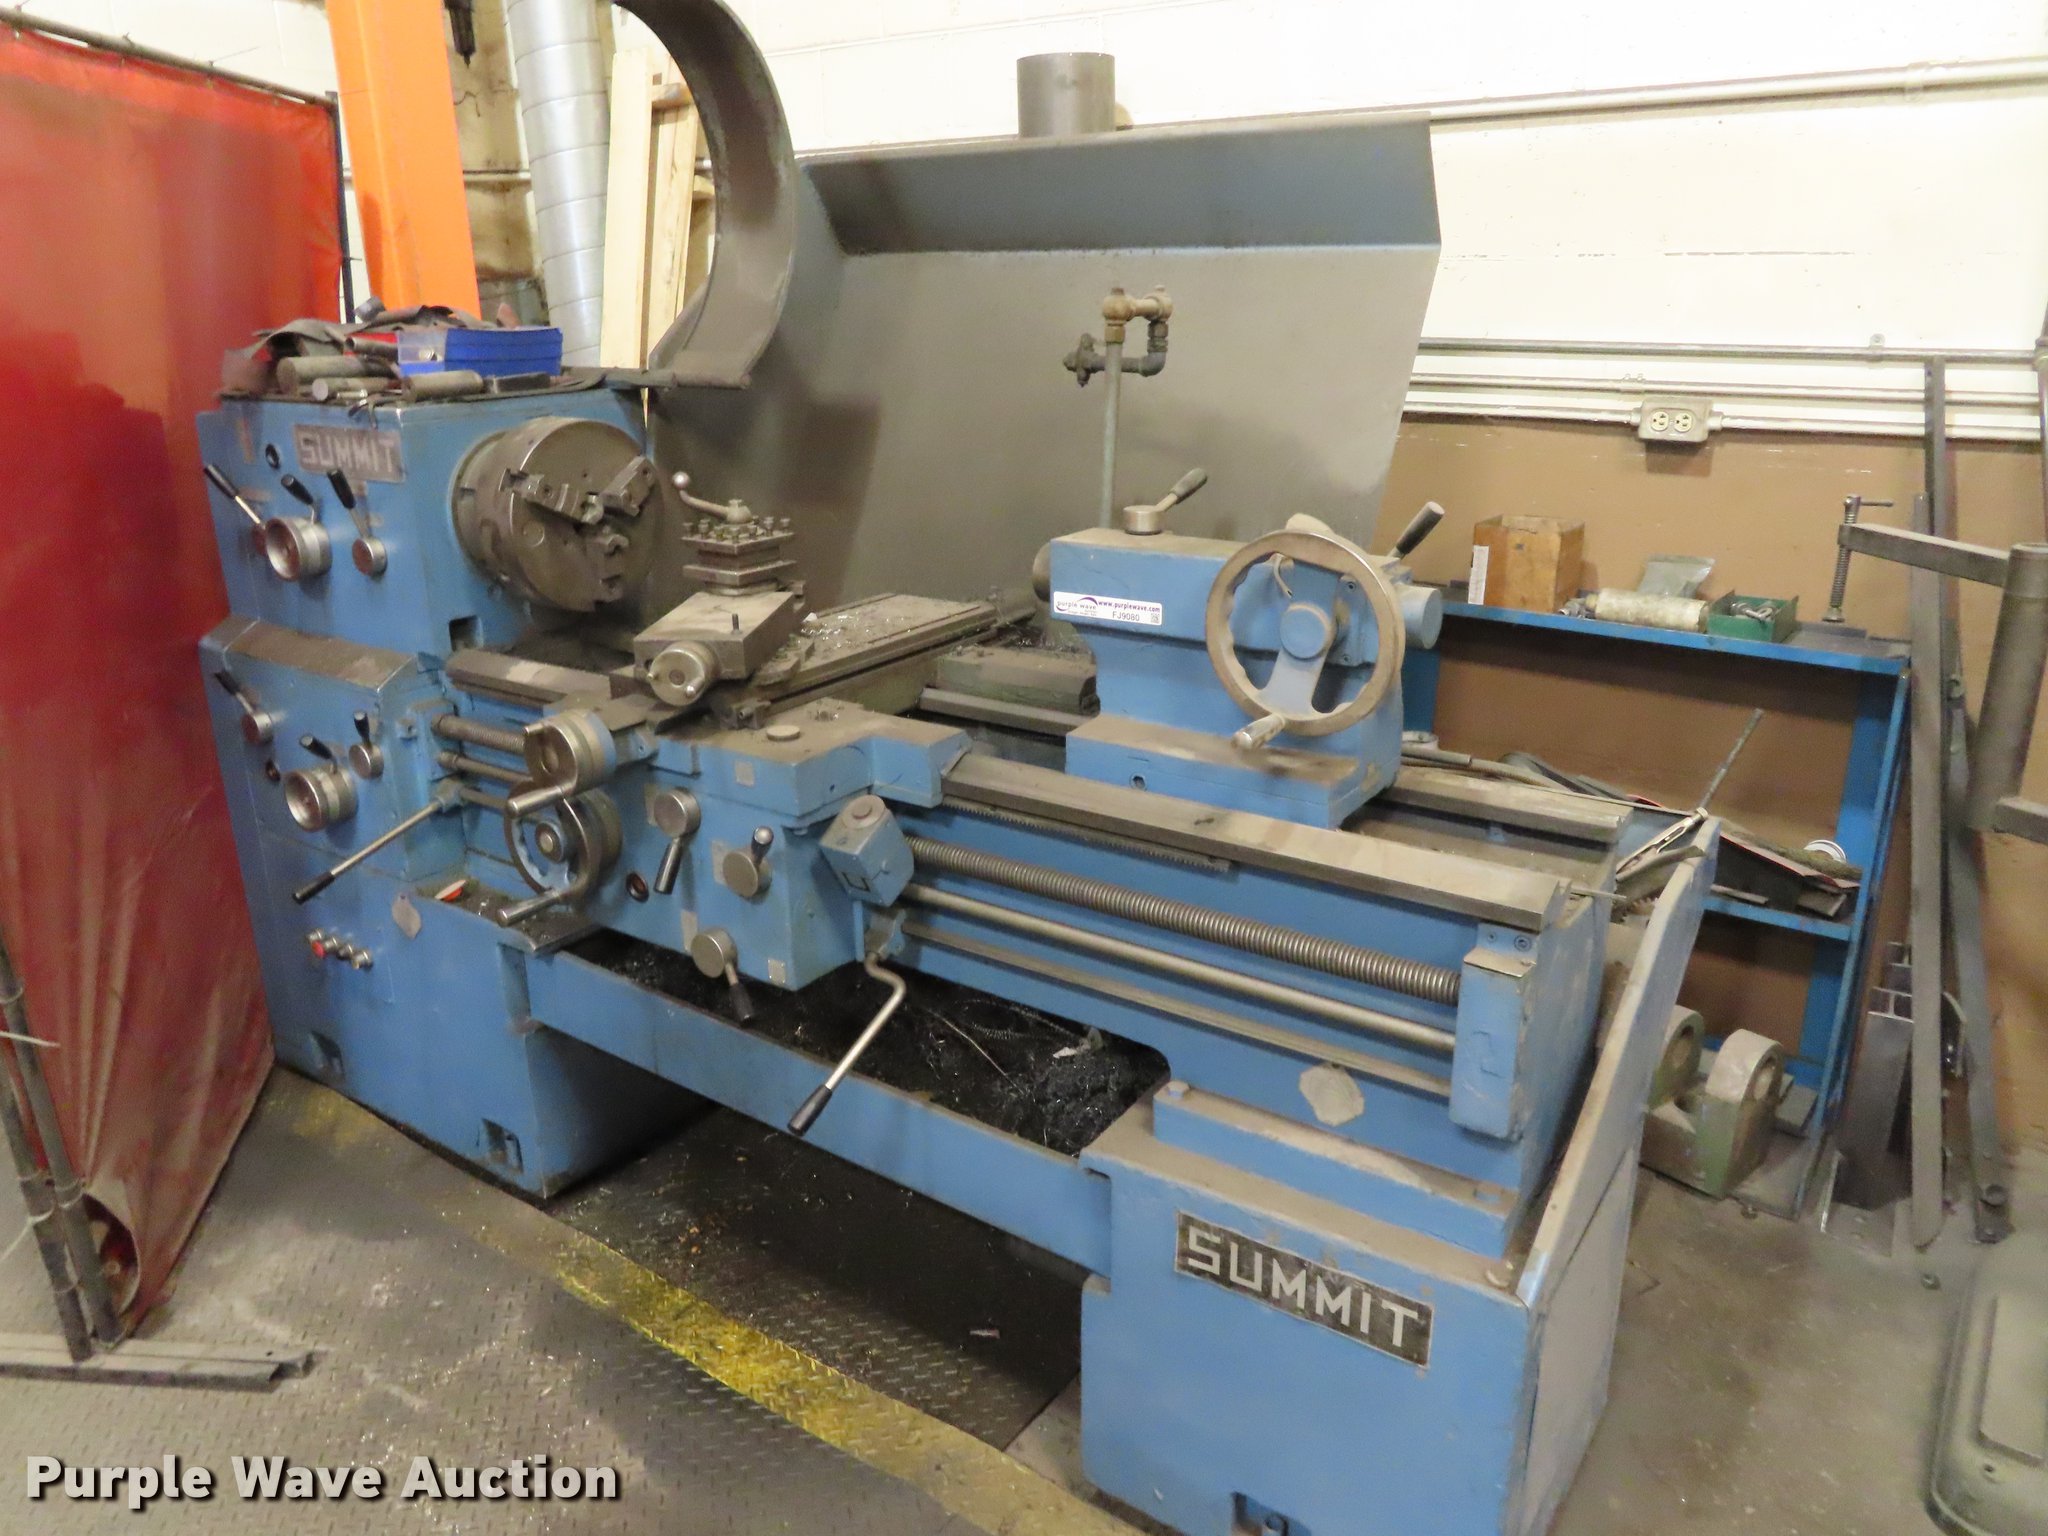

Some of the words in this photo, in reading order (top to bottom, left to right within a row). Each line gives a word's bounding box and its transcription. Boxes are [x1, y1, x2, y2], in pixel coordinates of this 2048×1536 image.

[301, 432, 396, 473] SUMMIT
[1057, 600, 1078, 608] purple
[1098, 600, 1160, 613] www.purplewave.com
[1187, 1225, 1419, 1347] SUMMIT
